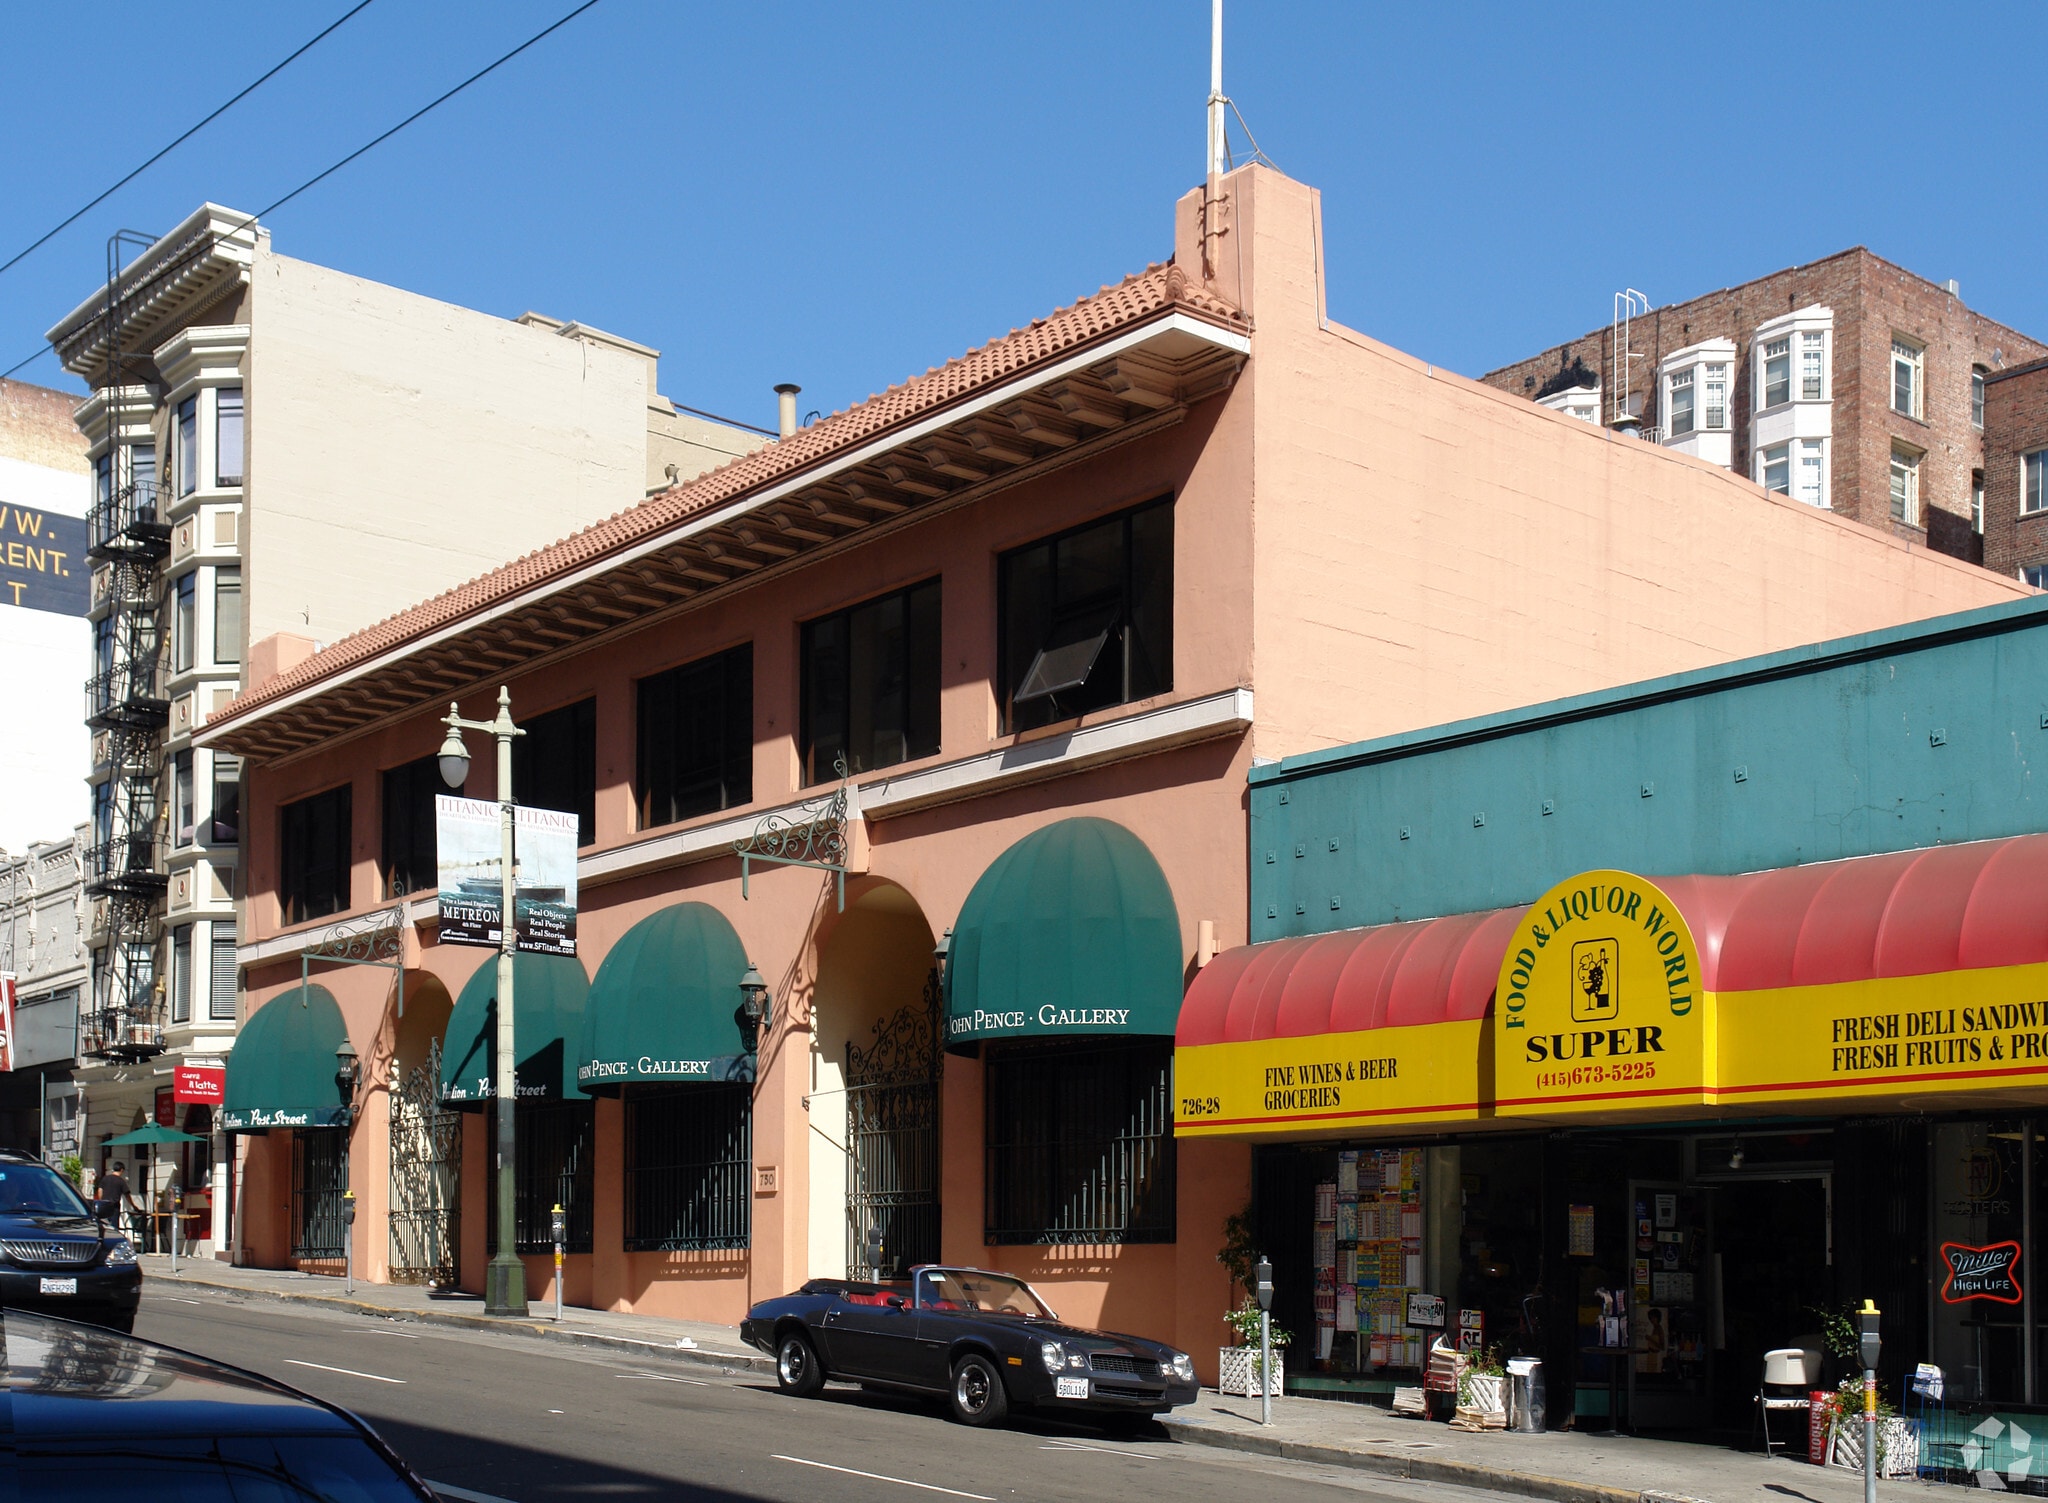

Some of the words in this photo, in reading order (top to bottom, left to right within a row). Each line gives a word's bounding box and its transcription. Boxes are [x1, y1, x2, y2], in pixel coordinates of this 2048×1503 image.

[0, 506, 56, 539] W.
[438, 797, 499, 818] TITANIC
[516, 808, 576, 830] TITANIC
[443, 906, 500, 924] METREON
[529, 908, 543, 917] Real
[543, 910, 567, 920] Objects
[530, 918, 544, 927] Real
[545, 919, 566, 930] People
[529, 928, 543, 937] Real
[544, 930, 566, 939] Stories
[519, 941, 575, 955] www.SFTitanic.com
[1505, 947, 1537, 1031] FOOD
[1531, 924, 1551, 949] &
[1545, 884, 1643, 935] LIQUOR
[1643, 904, 1693, 1017] WORLD
[949, 1015, 973, 1041] JOHN
[974, 1009, 1025, 1031] PENCE
[1038, 1004, 1130, 1026] GALLERY
[1832, 1014, 1900, 1043] FRESH
[1906, 1009, 1956, 1037] DELI
[1526, 1025, 1666, 1064] SUPER
[1832, 1043, 1899, 1072] FRESH
[1905, 1036, 1982, 1067] FRUITS
[1989, 1035, 2004, 1061] &
[592, 1059, 628, 1077] PENCE
[637, 1056, 711, 1074] GALLERY
[1265, 1065, 1295, 1088] FINE
[1298, 1062, 1342, 1085] WINES
[1345, 1061, 1356, 1082] &
[1359, 1057, 1398, 1081] BEER
[1536, 1061, 1656, 1090] (415)673-5225
[1182, 1097, 1221, 1116] 726-28
[1264, 1086, 1341, 1111] GROCERIES
[250, 1108, 271, 1126] Post
[270, 1110, 308, 1126] Street
[1950, 1249, 2013, 1274] Miller
[1953, 1278, 1981, 1292] HIGH
[1984, 1278, 2011, 1291] LIFE
